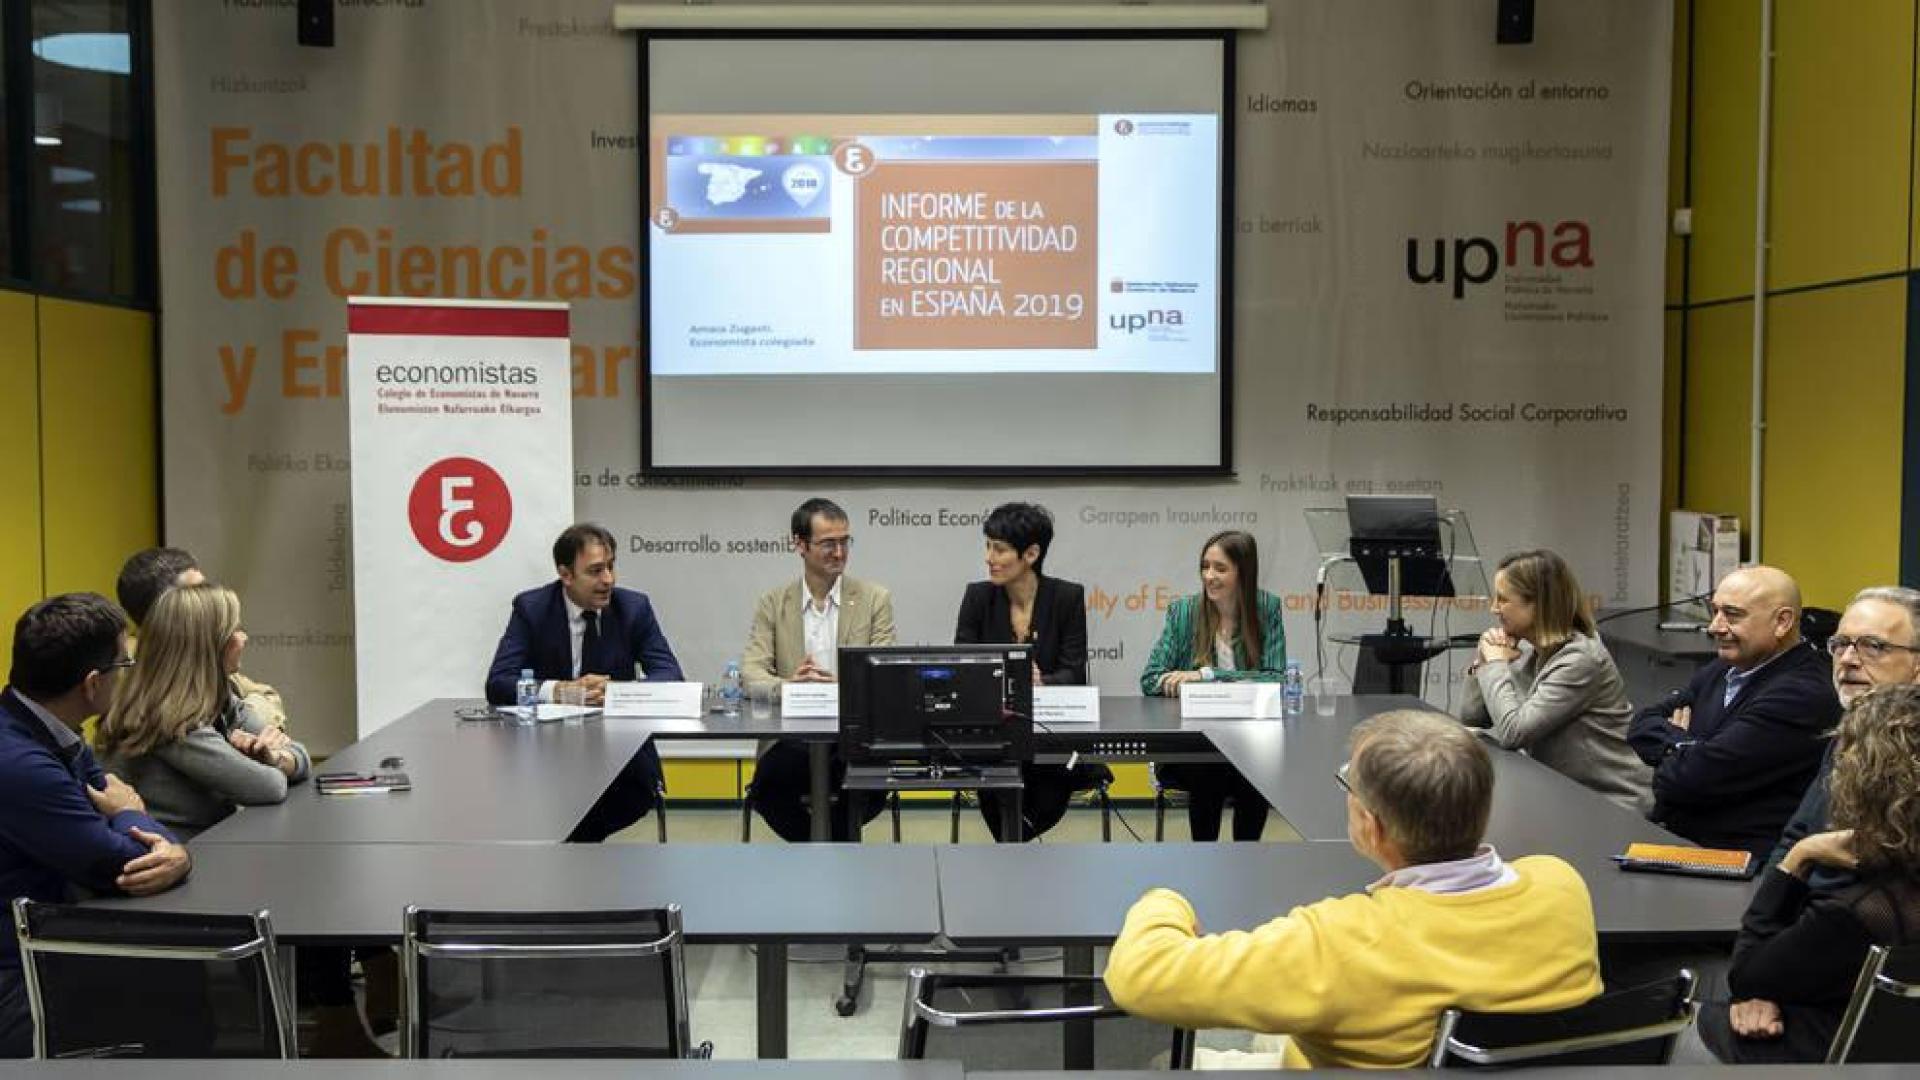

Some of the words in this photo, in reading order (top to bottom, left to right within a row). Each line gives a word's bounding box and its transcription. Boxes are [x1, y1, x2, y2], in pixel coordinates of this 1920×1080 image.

[1405, 81, 1512, 100] Orientación
[1518, 81, 1536, 99] al
[1541, 84, 1610, 100] entorno
[1247, 95, 1318, 113] Idiomas
[211, 125, 522, 198] Facultad
[881, 193, 987, 220] INFORME
[994, 200, 1017, 219] DE
[1021, 200, 1044, 219] LA
[881, 225, 1078, 252] COMPETITIVIDAD
[215, 231, 299, 299] de
[324, 226, 636, 299] Ciencias
[881, 257, 1002, 284] REGIONAL
[1406, 220, 1595, 299] upna
[881, 298, 904, 317] EN
[911, 285, 1006, 317] ESPAÑA
[1013, 293, 1084, 321] 2019
[1110, 309, 1183, 335] upna
[219, 343, 257, 415] y
[376, 361, 539, 385] economistas
[1306, 404, 1453, 427] Responsabilidad
[1459, 403, 1516, 423] Social
[1521, 404, 1629, 427] Corporativa
[597, 468, 620, 487] de
[868, 506, 932, 527] Política
[1079, 505, 1160, 528] Garapen
[1166, 503, 1258, 524] Iraunkorra
[630, 534, 721, 553] Desarrollo
[1125, 583, 1150, 611] of
